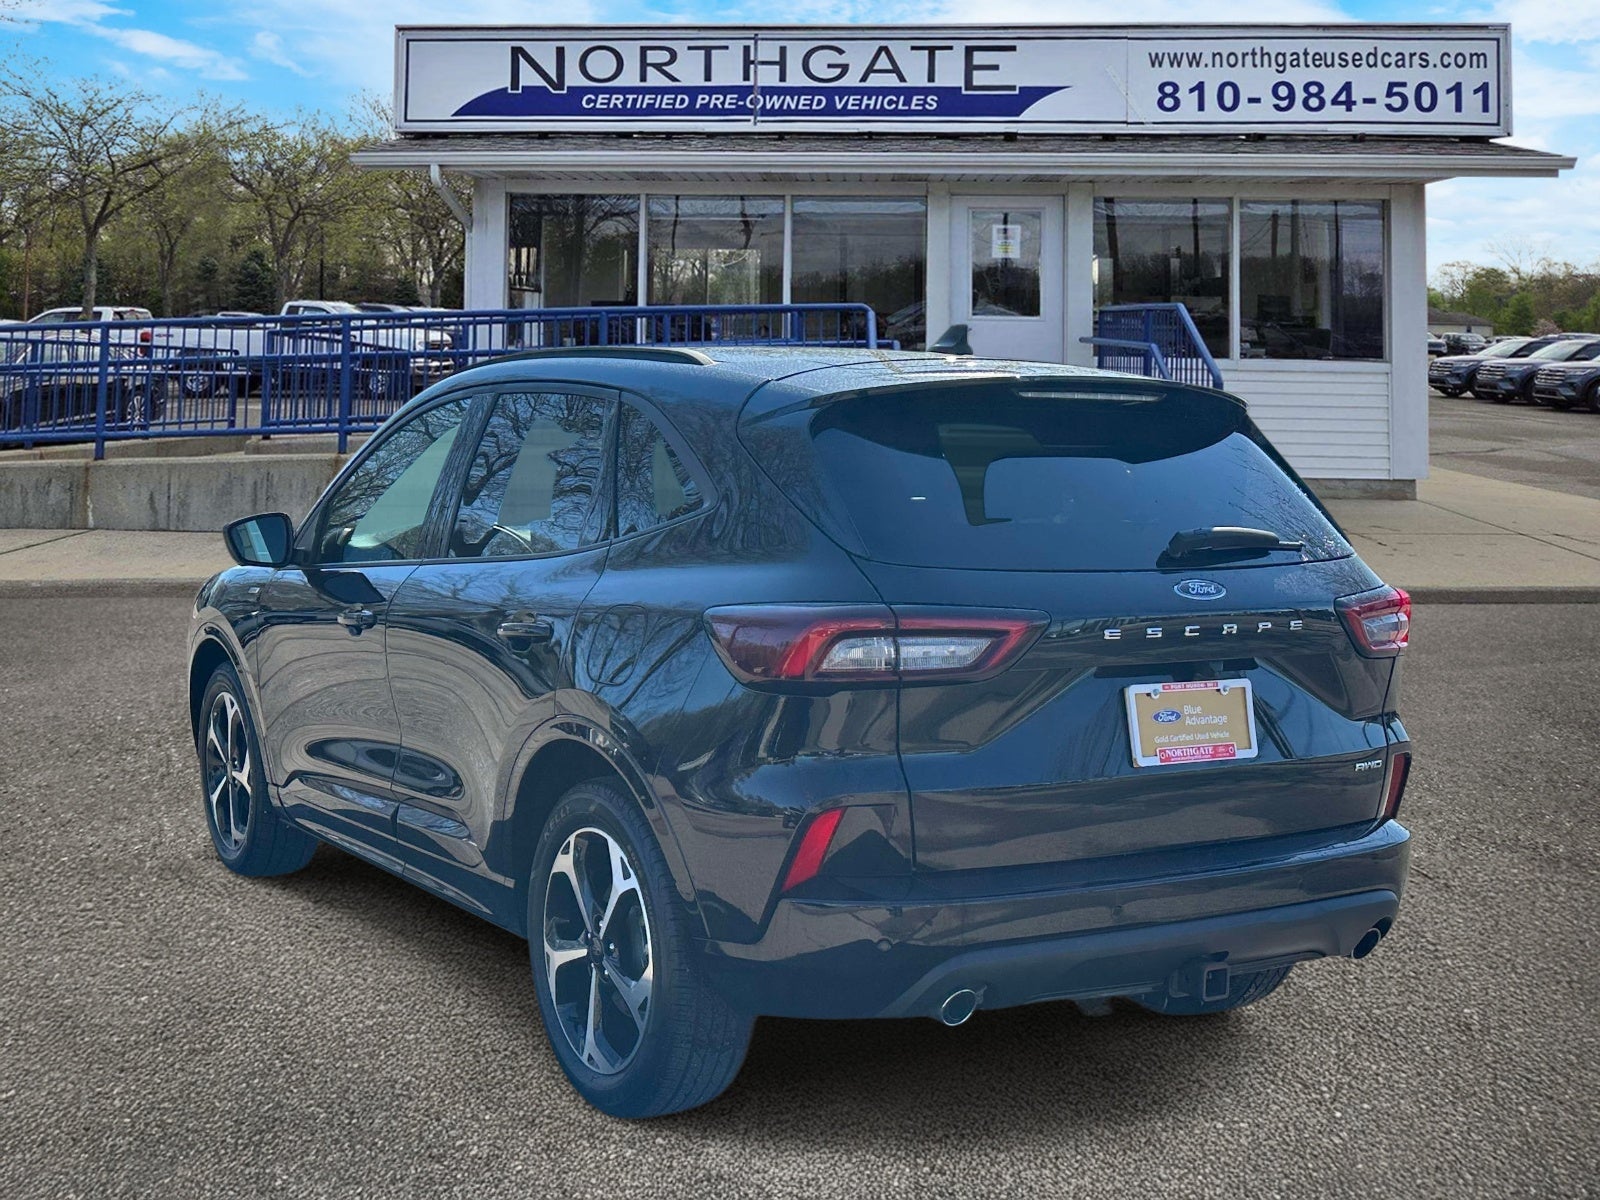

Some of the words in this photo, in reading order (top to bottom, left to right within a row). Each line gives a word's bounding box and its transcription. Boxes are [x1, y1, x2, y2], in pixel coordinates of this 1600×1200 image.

[1148, 46, 1488, 74] www.northgateusedcars.com
[510, 44, 1018, 93] NORTHGATE
[581, 94, 689, 110] CERTIFIED
[695, 94, 827, 110] PRE-OWNED
[834, 95, 938, 110] VEHICLES
[1156, 80, 1491, 113] 810-984-5011
[1103, 620, 1303, 640] ESCAPE
[1183, 704, 1202, 715] Blue
[1185, 714, 1228, 726] Advantage
[1165, 746, 1215, 758] NORTHGATE
[1355, 759, 1383, 771] AWD
